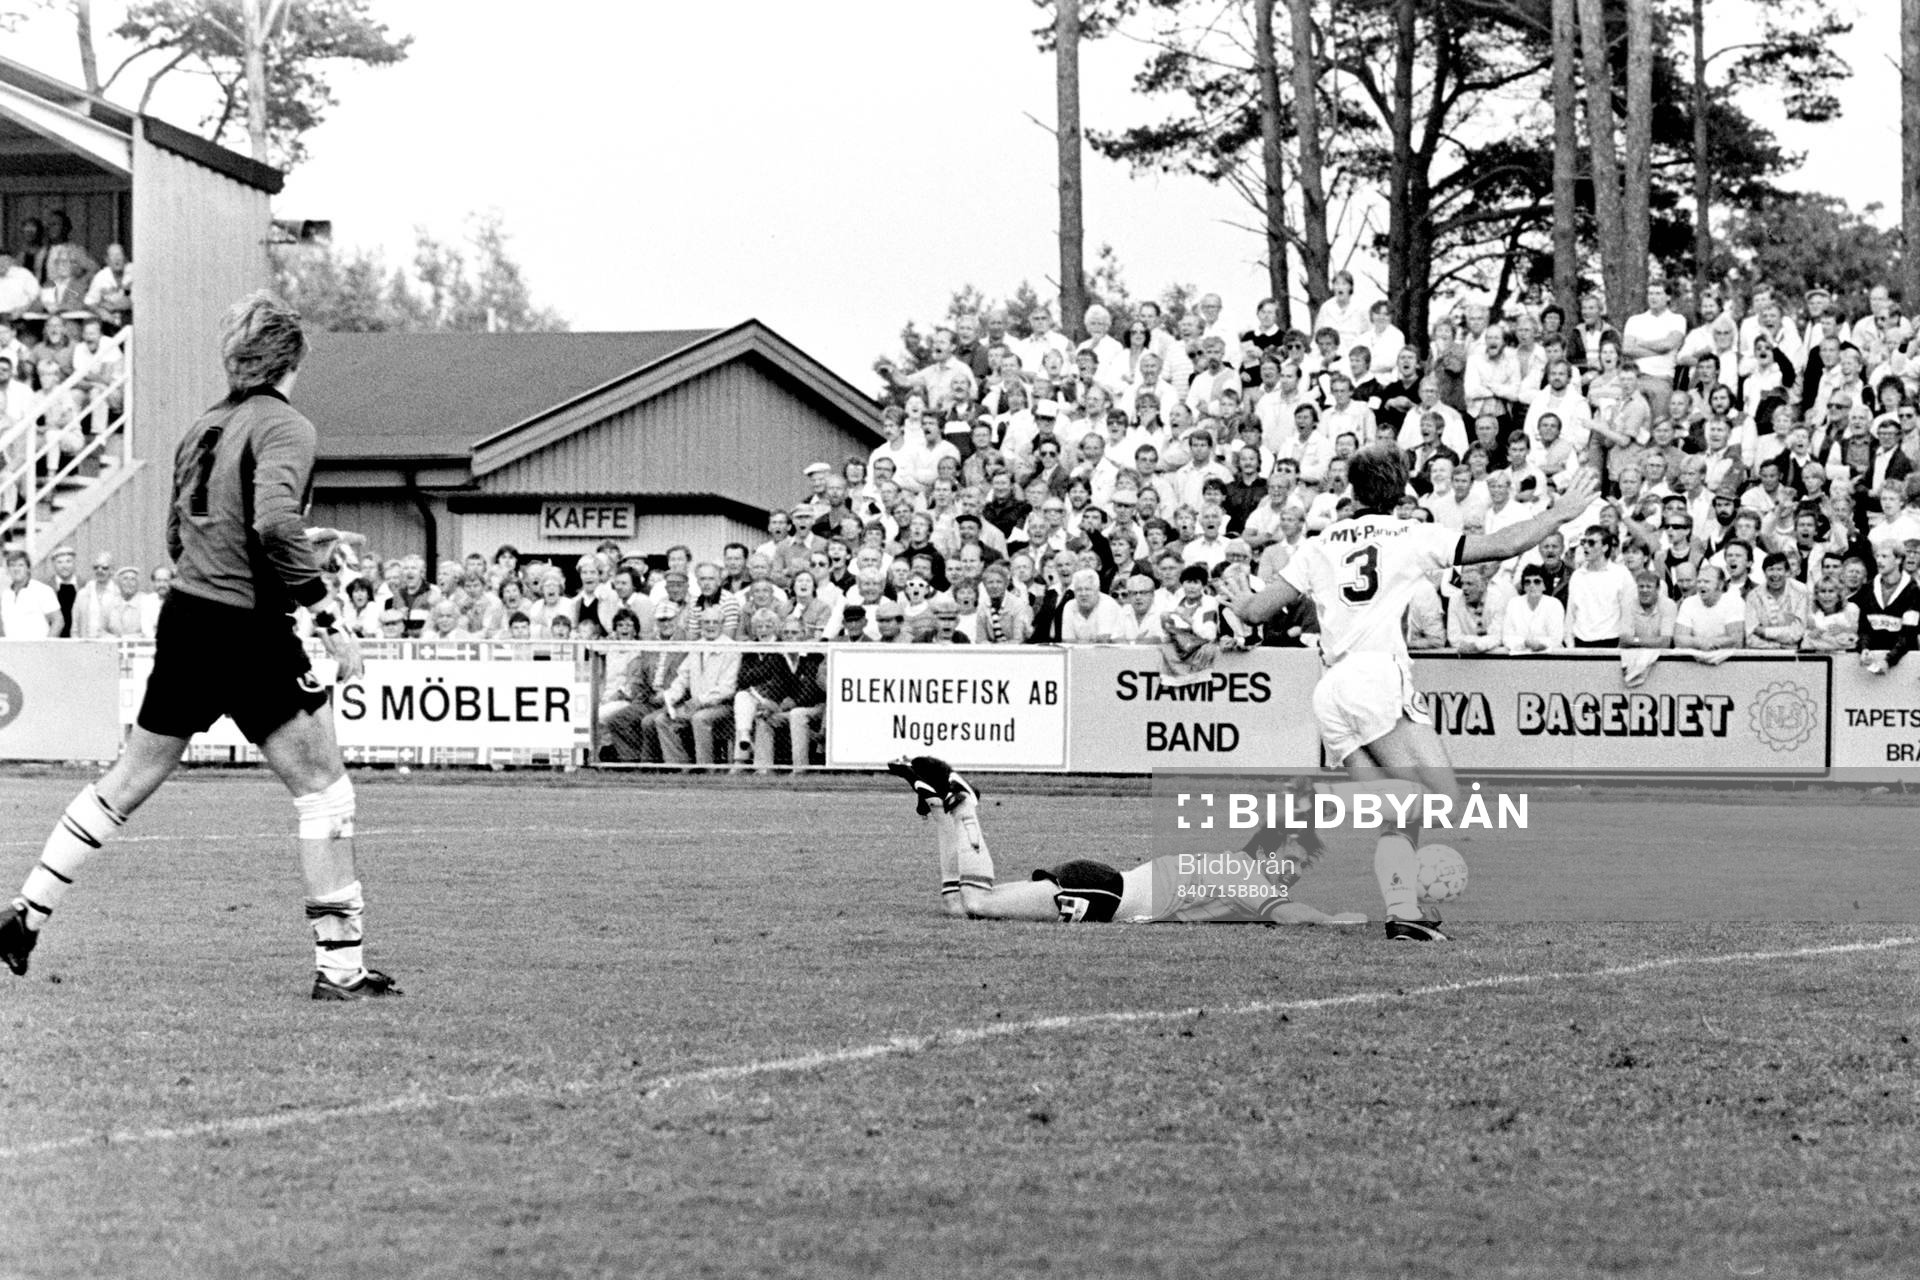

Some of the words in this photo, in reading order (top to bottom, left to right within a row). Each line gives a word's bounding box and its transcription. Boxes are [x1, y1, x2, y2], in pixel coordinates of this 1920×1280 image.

[545, 507, 628, 528] KAFFE
[1341, 544, 1380, 604] 3
[382, 677, 570, 721] MÖBLER
[841, 678, 1010, 705] BLEKINGEFISK
[1029, 680, 1058, 705] AB
[1517, 692, 1735, 737] BAGERIET
[1845, 708, 1920, 727] TAPETS
[893, 715, 1015, 746] Nogersund
[1146, 721, 1240, 752] BAND
